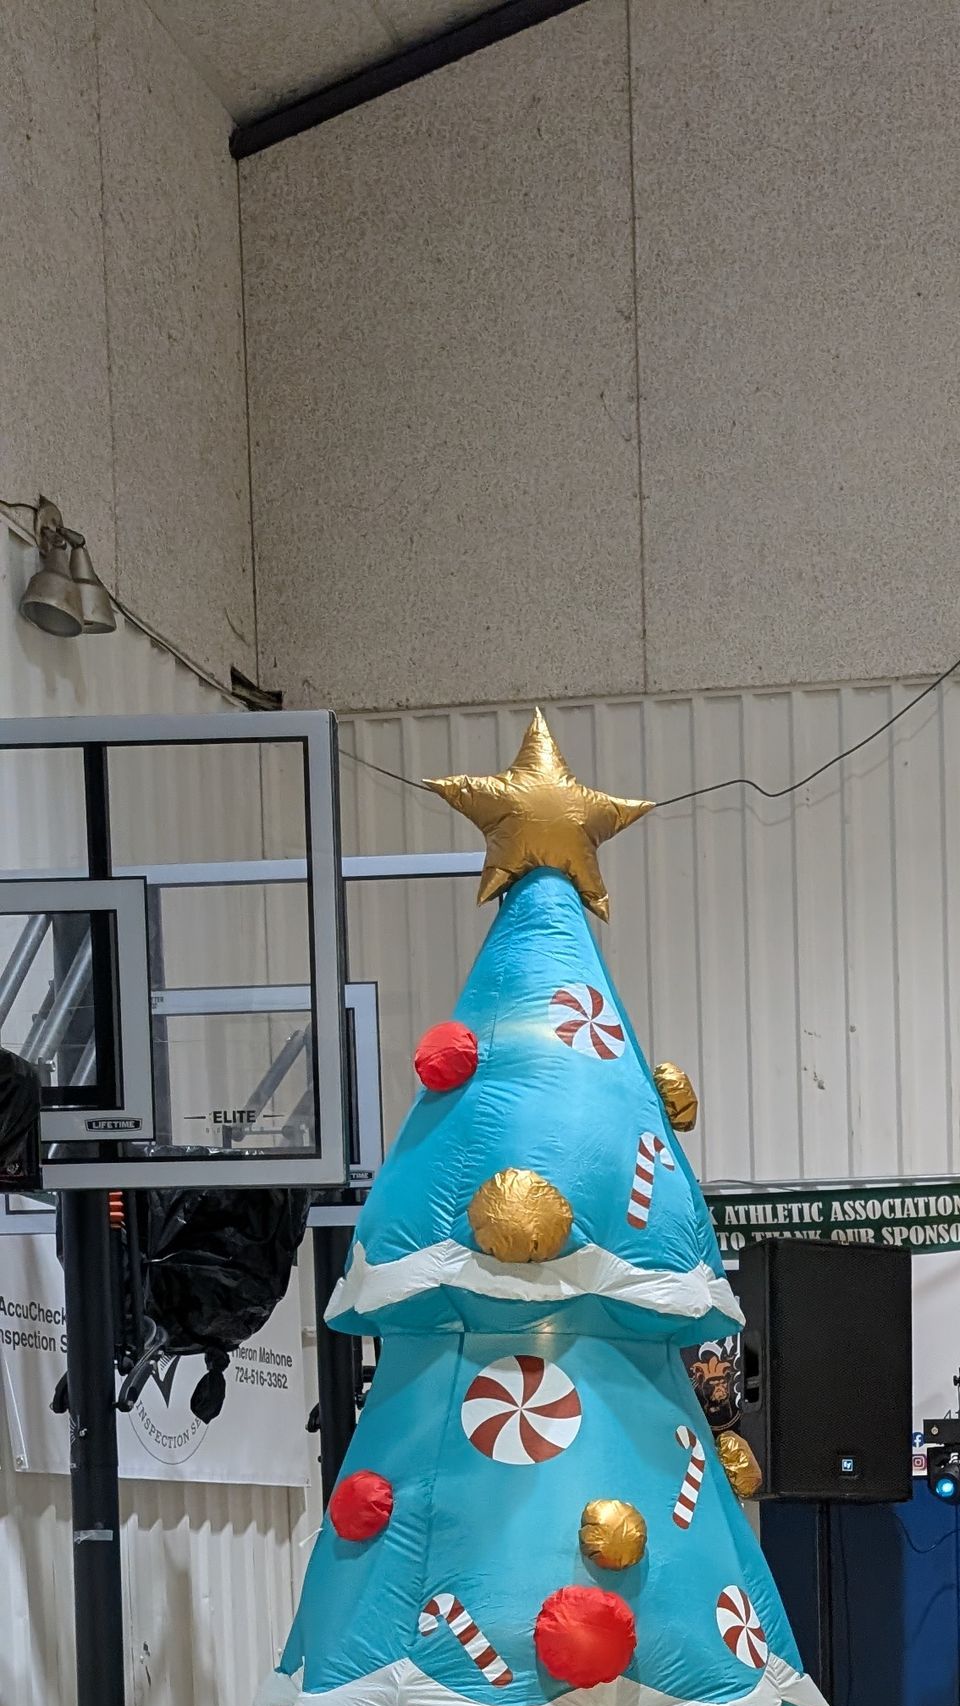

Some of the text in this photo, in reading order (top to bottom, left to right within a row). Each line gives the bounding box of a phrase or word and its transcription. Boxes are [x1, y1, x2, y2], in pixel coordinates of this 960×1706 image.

[92, 1119, 137, 1130] LIFETIME
[213, 1109, 257, 1124] ELITE
[723, 1201, 824, 1225] ATHLETIC
[717, 1231, 746, 1251] TO
[830, 1228, 875, 1244] OUR
[259, 1347, 293, 1368] Mahone
[235, 1366, 288, 1389] 724-516-3362
[135, 1400, 190, 1449] INSPECTION
